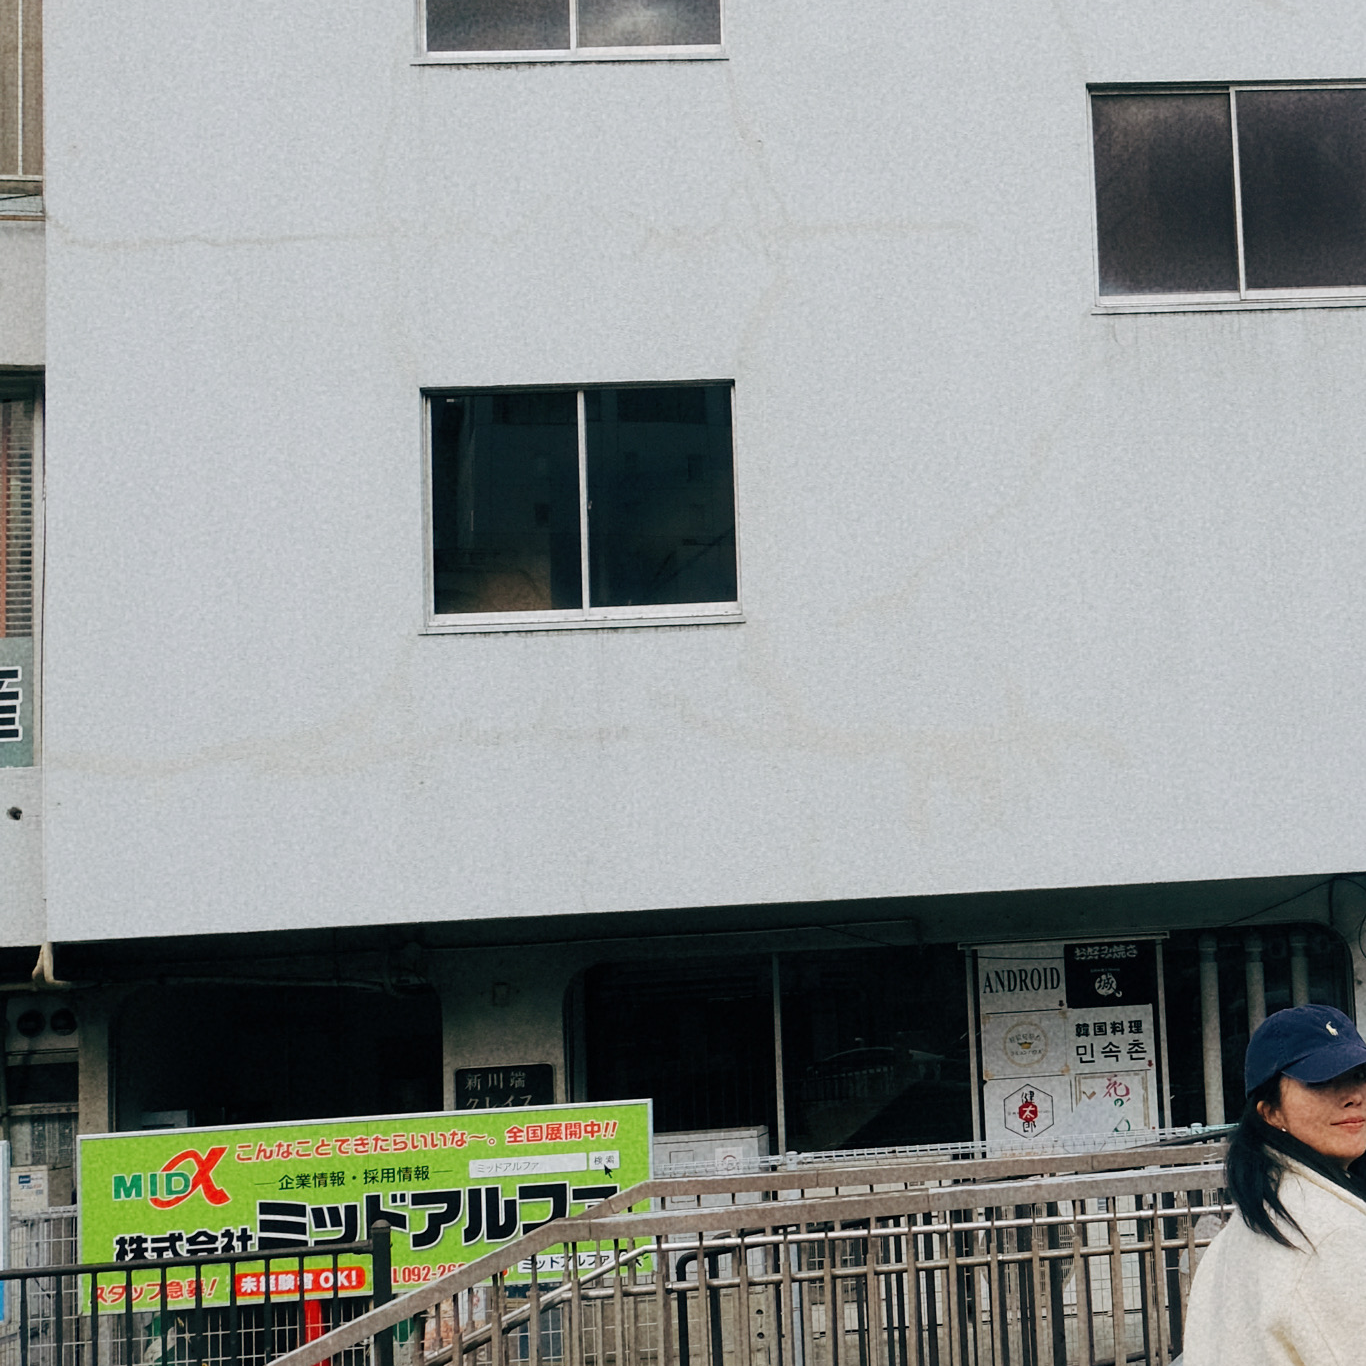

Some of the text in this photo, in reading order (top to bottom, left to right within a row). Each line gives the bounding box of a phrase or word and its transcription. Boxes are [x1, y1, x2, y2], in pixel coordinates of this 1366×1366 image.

[983, 967, 1061, 994] ANDROID
[1075, 1020, 1144, 1037] 韓国料理
[1075, 1039, 1147, 1064] 민속촌
[465, 1071, 526, 1091] 新川端
